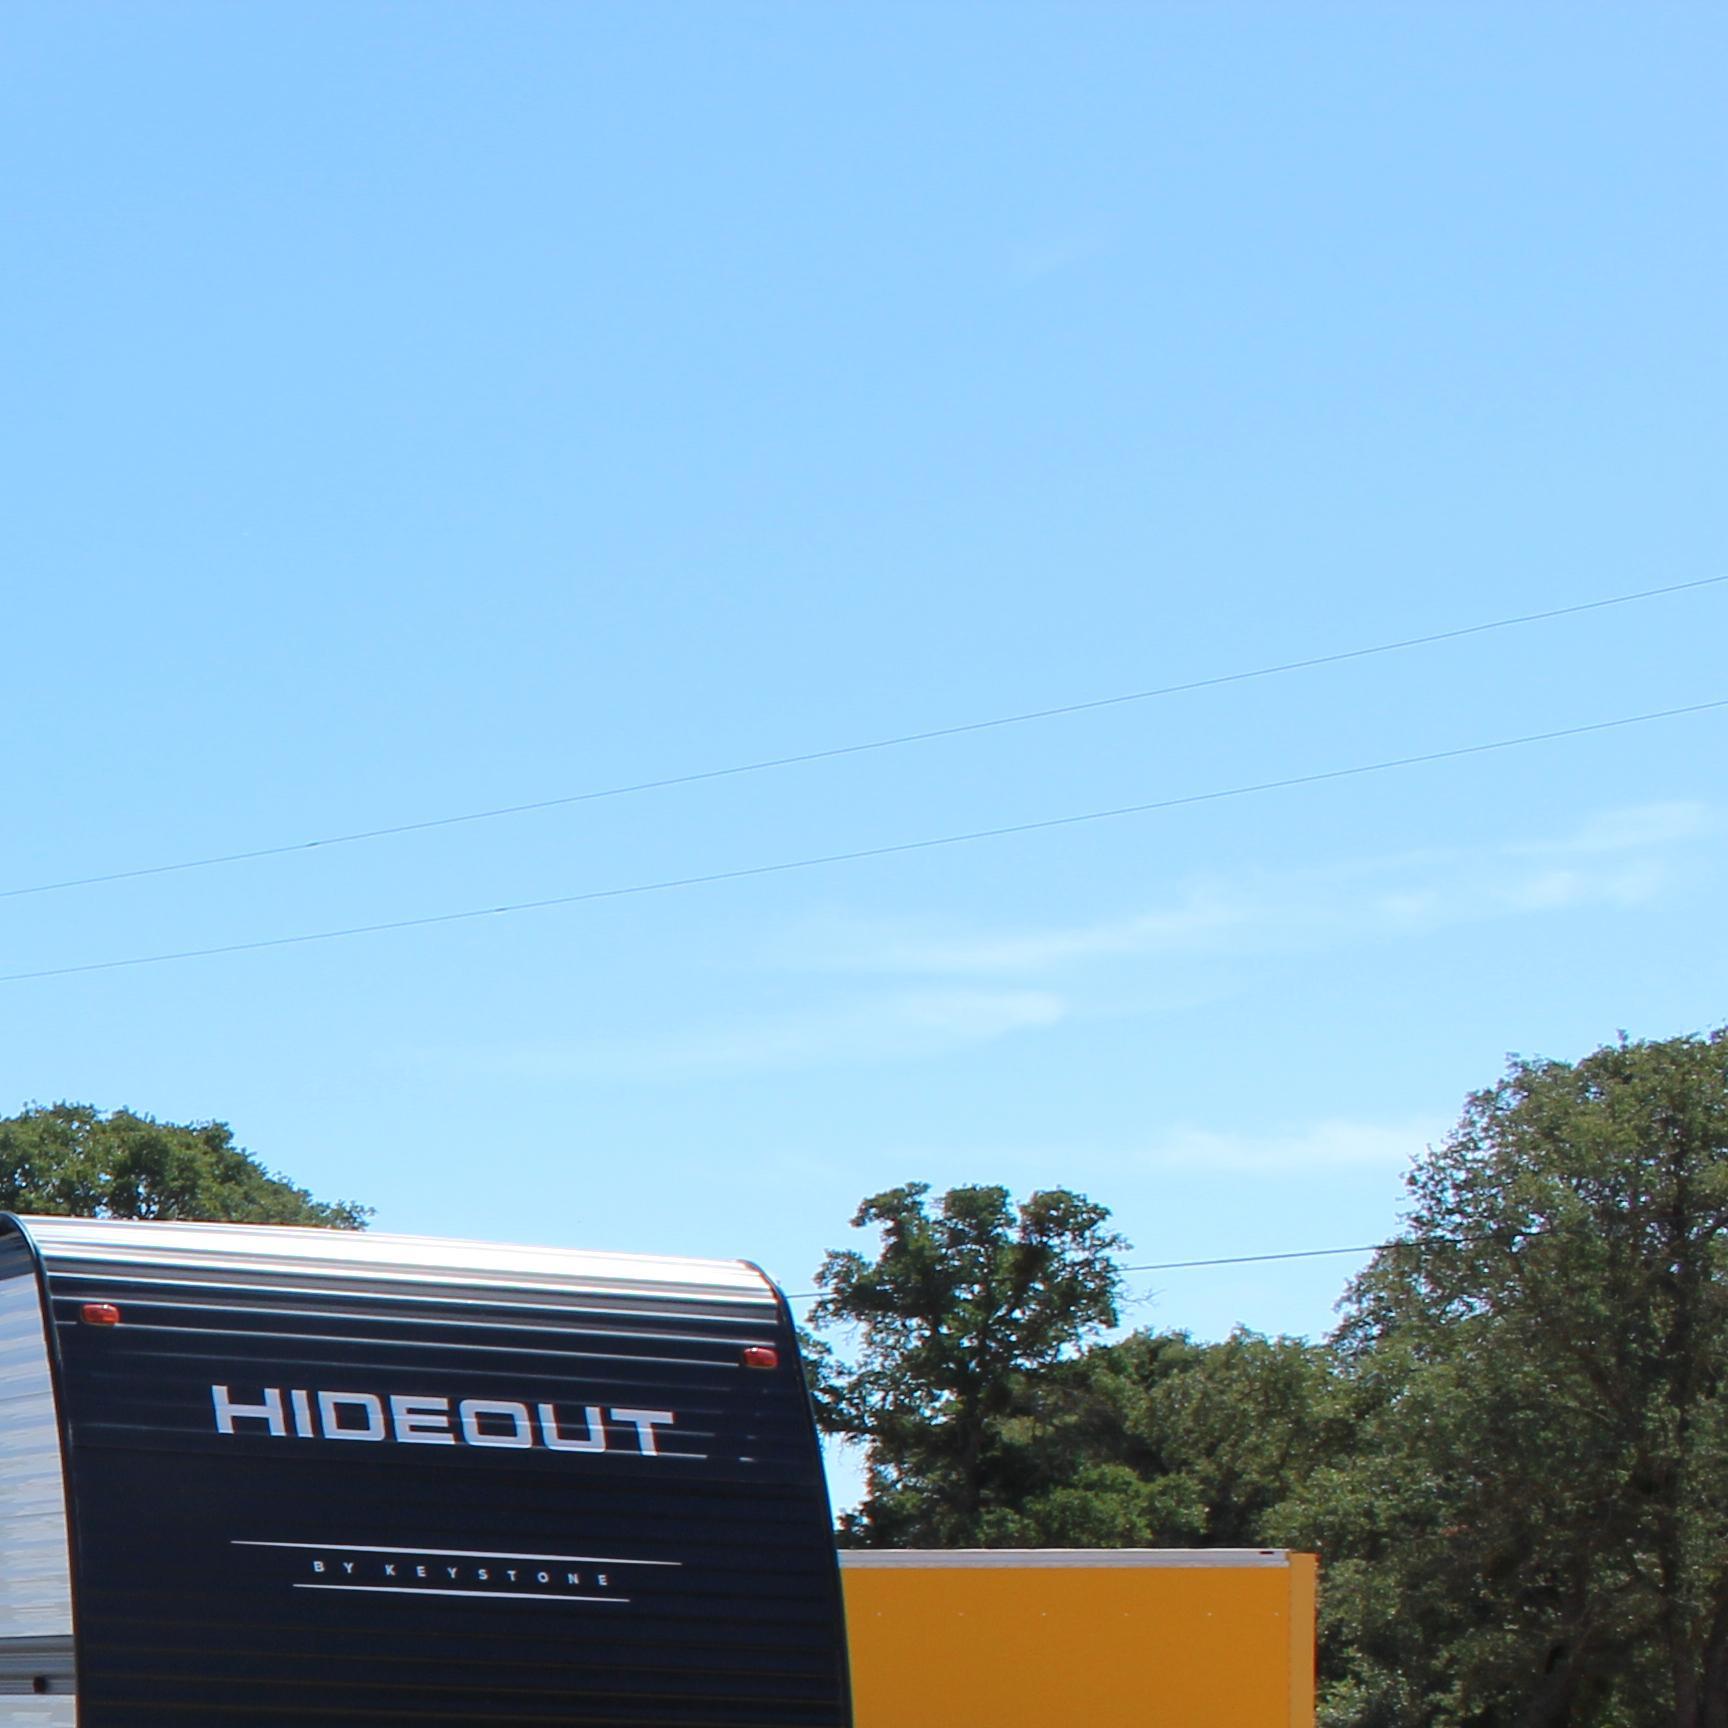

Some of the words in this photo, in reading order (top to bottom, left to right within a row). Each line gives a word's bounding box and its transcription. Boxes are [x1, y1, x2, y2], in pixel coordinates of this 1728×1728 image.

[211, 1384, 675, 1457] HIDEOUT
[313, 1560, 354, 1574] BY
[385, 1564, 609, 1587] KEYSTONE
